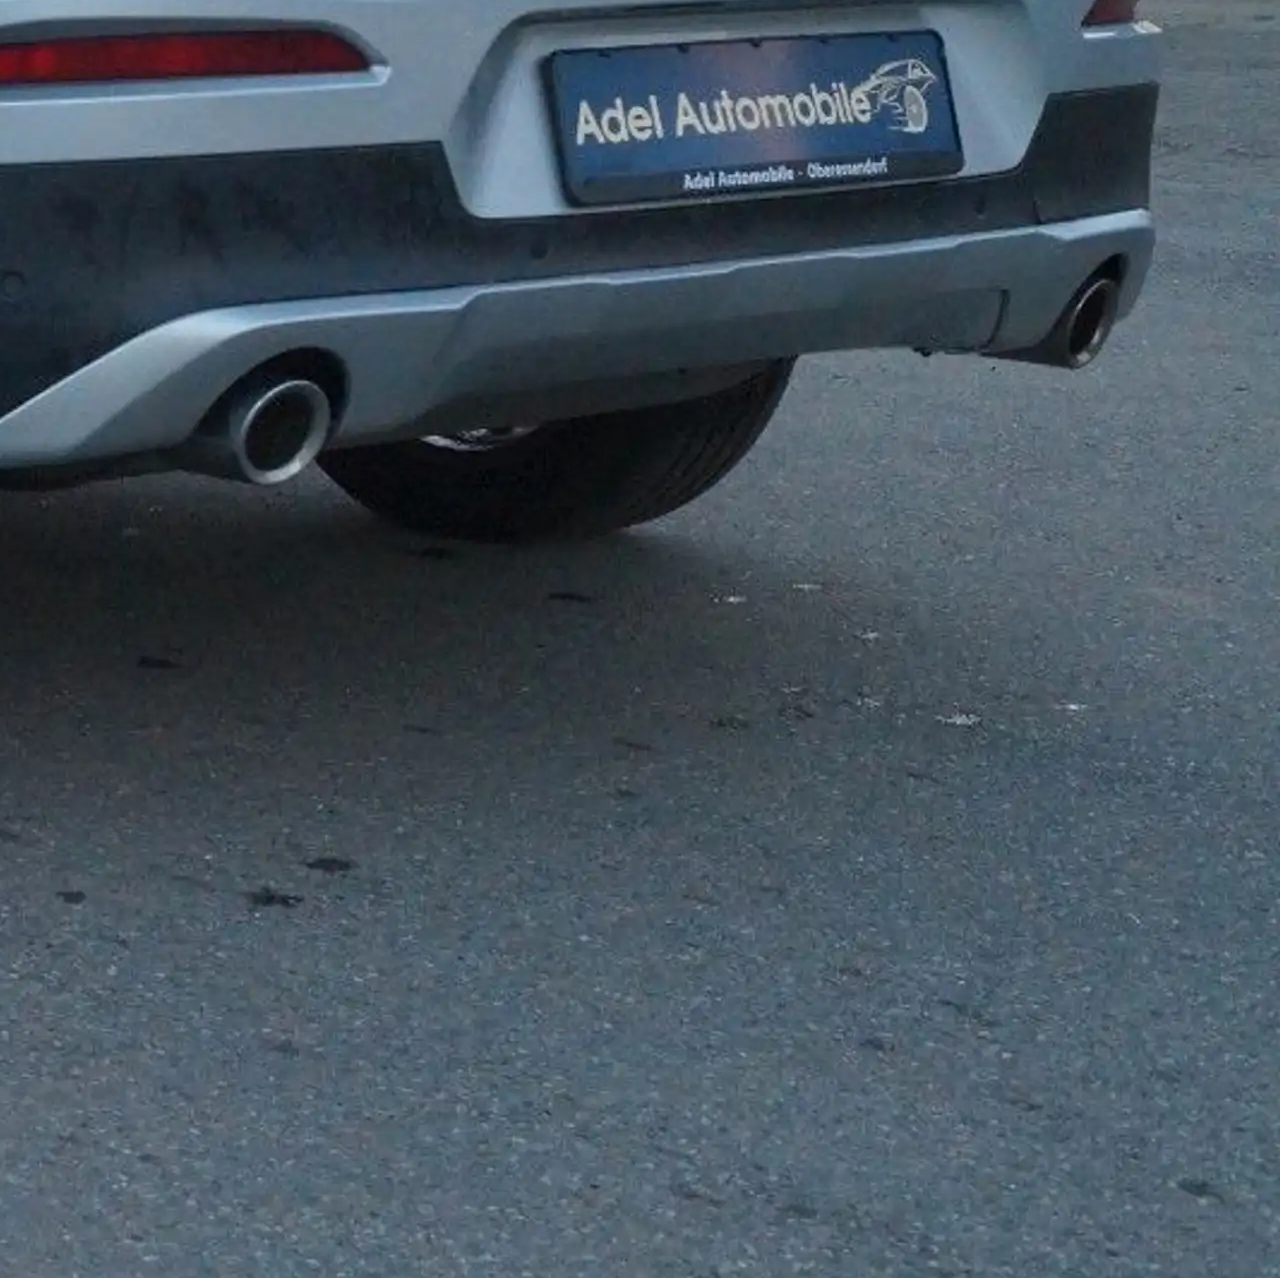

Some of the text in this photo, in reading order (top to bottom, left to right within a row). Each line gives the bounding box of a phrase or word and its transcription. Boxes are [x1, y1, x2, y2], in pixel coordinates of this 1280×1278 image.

[576, 81, 871, 146] Adel Automobile
[684, 171, 715, 190] Adel
